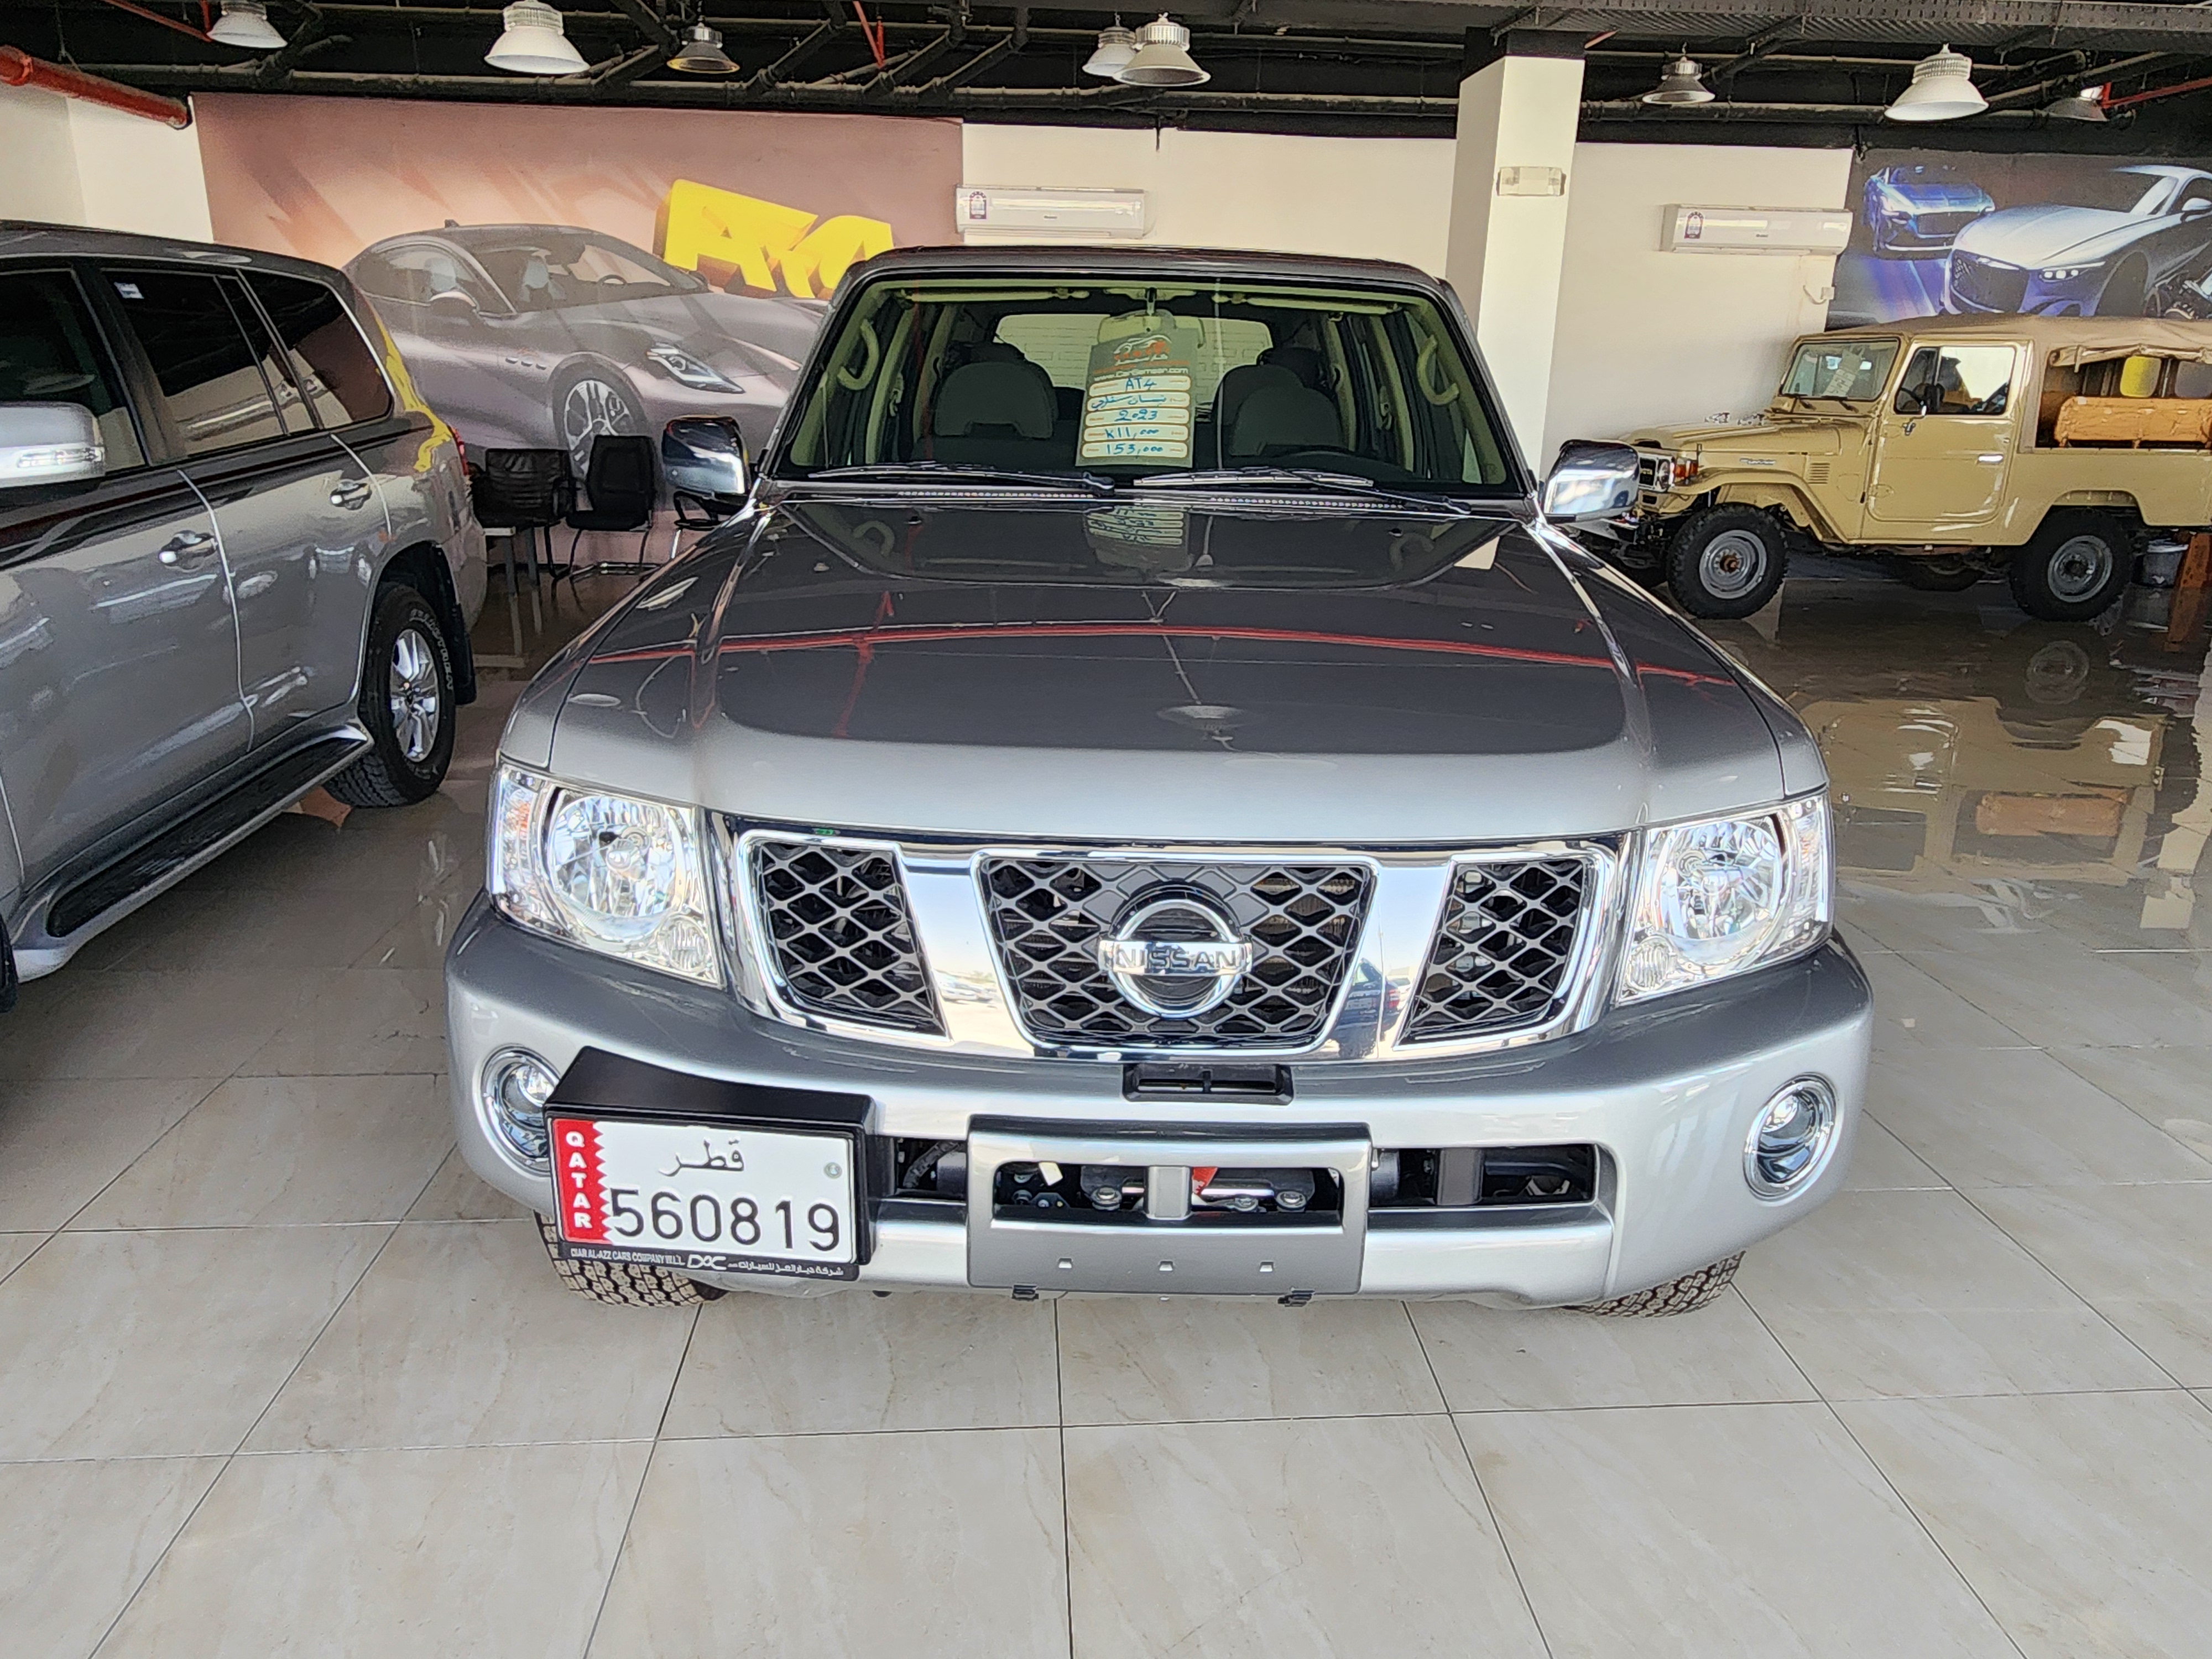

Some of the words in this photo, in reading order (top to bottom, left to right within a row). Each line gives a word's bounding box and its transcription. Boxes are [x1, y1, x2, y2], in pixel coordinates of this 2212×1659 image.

[1114, 409, 1158, 421] 2023
[1107, 443, 1164, 458] 153,000
[1115, 948, 1237, 969] NISSAN
[658, 1136, 745, 1177] قطر
[566, 1130, 593, 1229] QATAR
[610, 1187, 840, 1252] 560819
[613, 1251, 632, 1261] CARS
[632, 1251, 665, 1264] COMPANY
[816, 1266, 844, 1276] شركة
